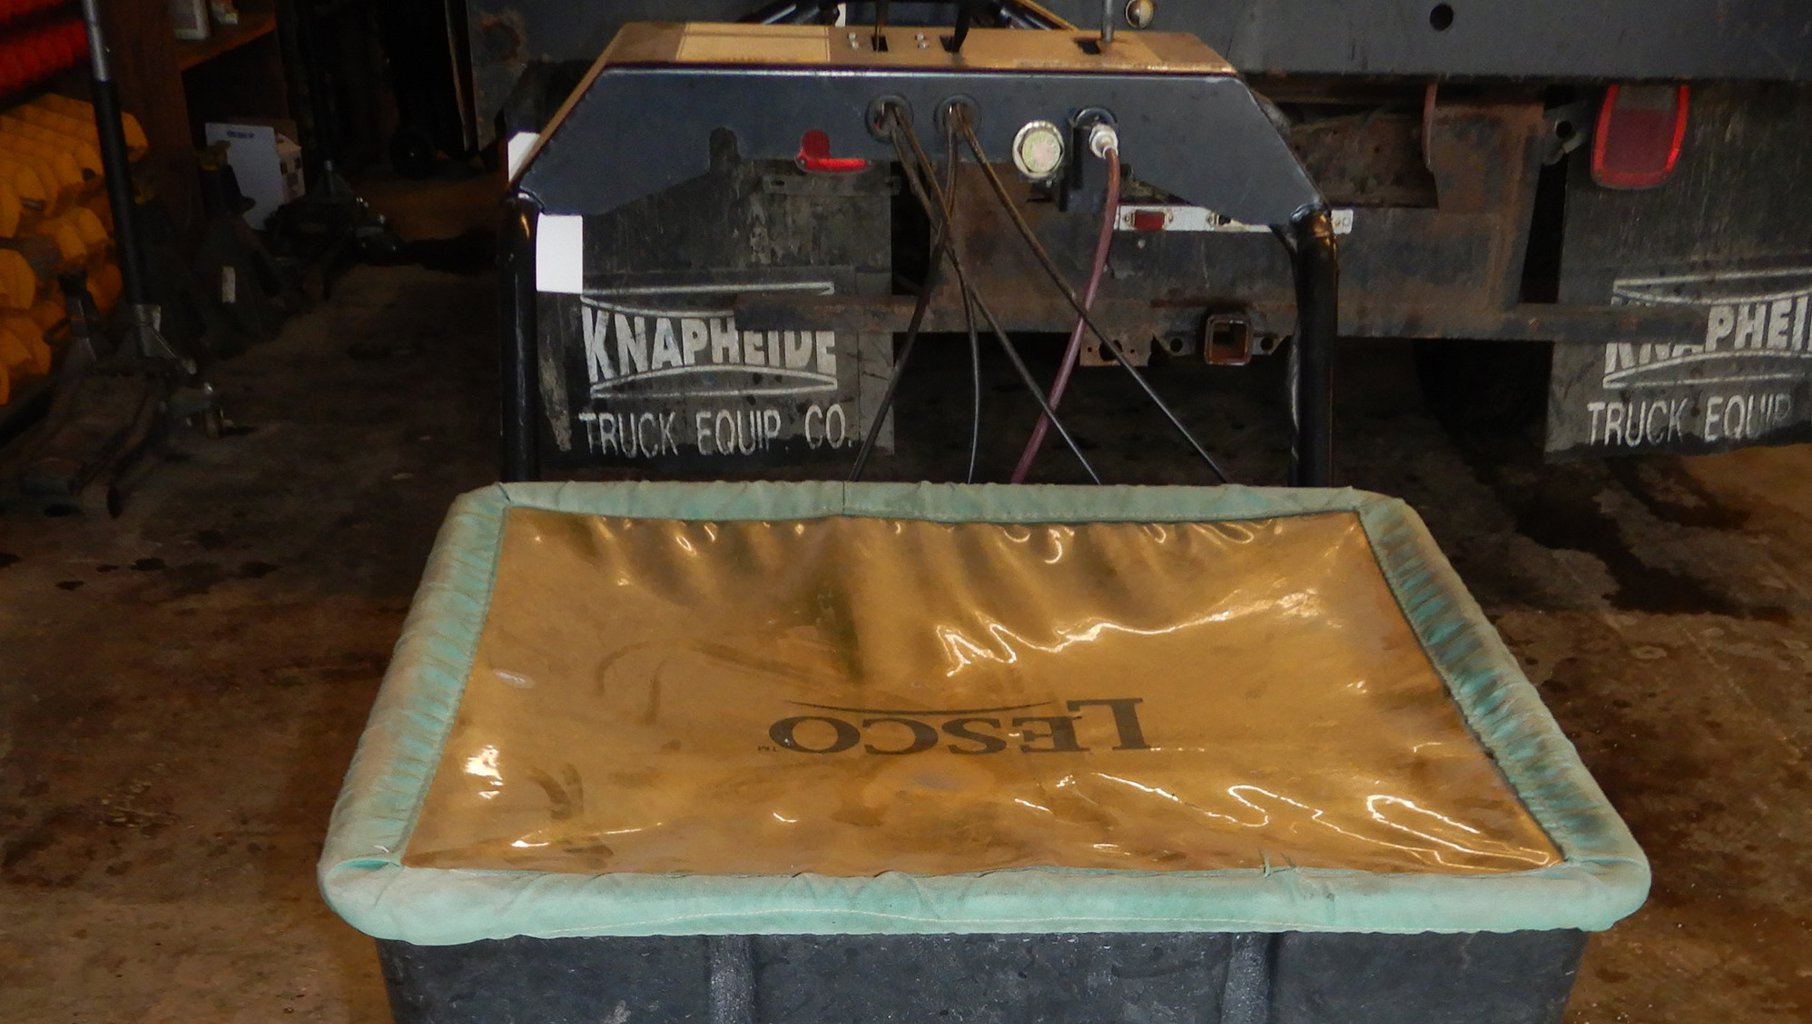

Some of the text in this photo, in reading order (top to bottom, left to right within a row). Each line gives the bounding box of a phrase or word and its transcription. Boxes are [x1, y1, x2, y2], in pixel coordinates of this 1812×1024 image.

[581, 305, 837, 383] KNAPHEIDE
[578, 411, 679, 459] TRUCK
[1586, 398, 1689, 447] TRUCK
